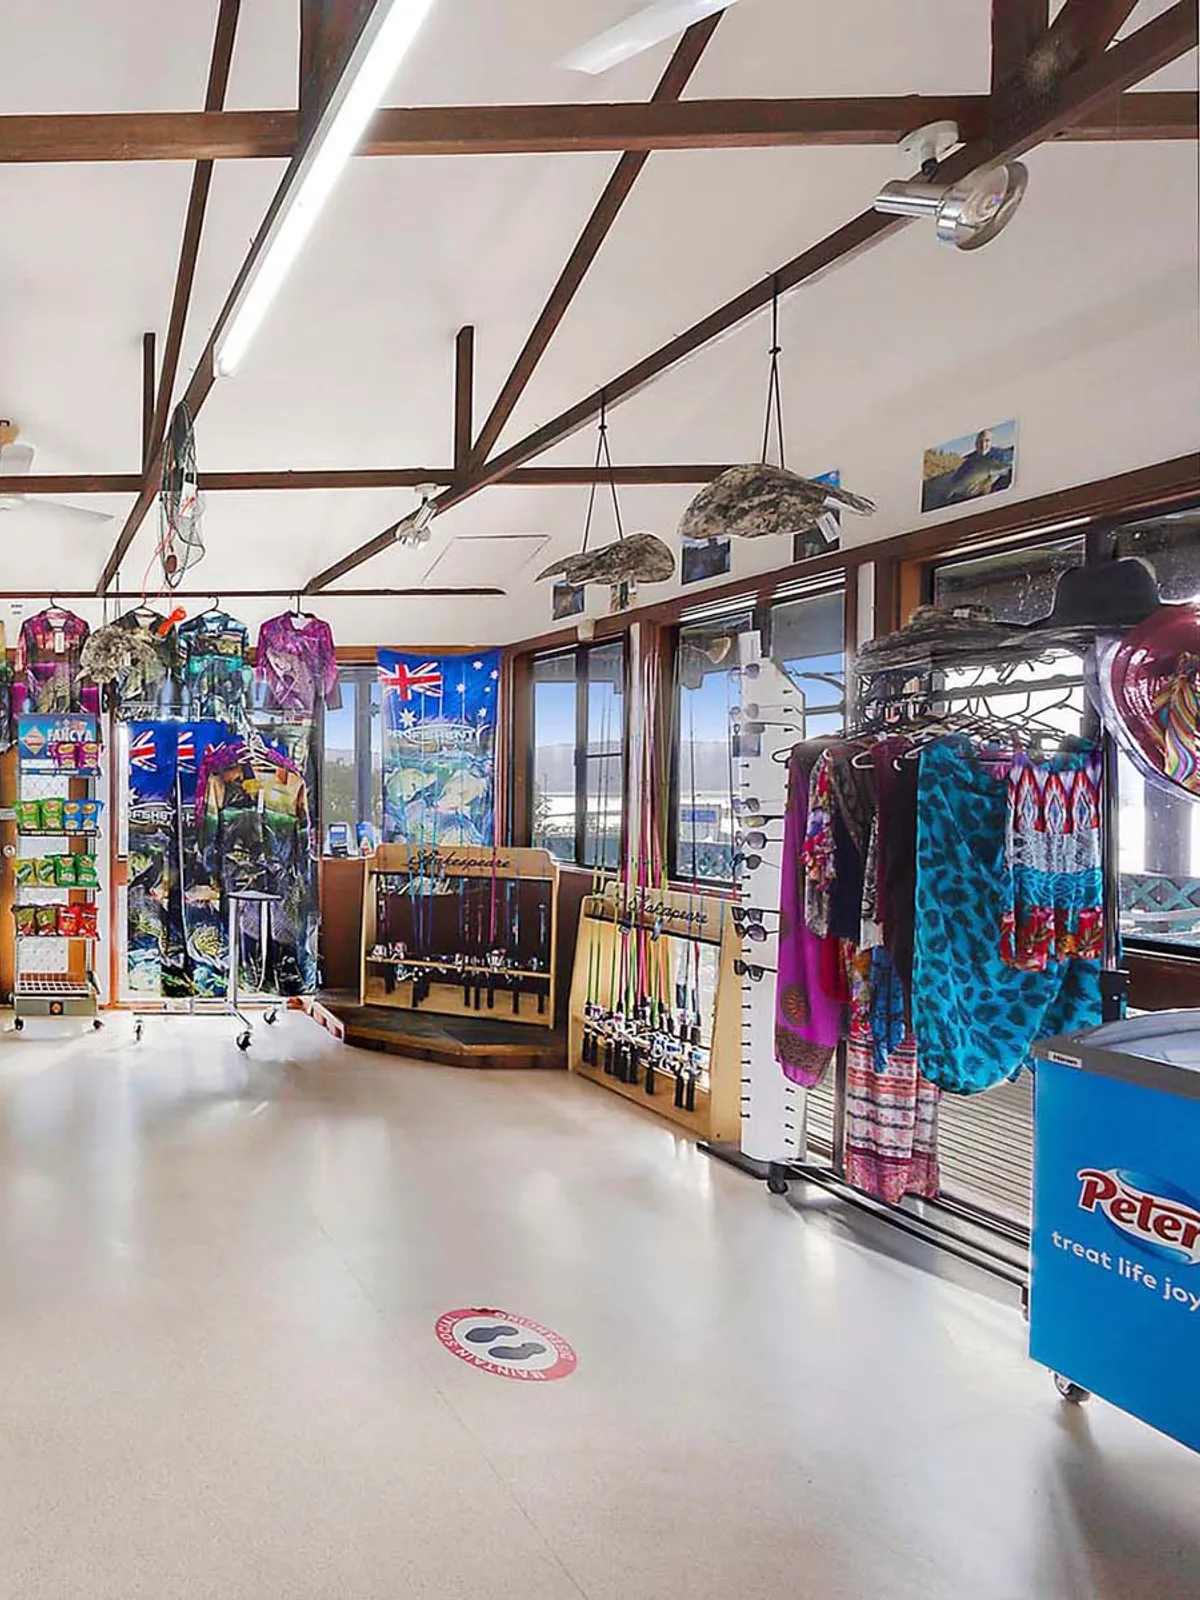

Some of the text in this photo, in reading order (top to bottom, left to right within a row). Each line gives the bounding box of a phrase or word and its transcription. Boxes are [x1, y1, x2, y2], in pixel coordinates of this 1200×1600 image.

[47, 729, 85, 742] FANCY
[1051, 1230, 1112, 1270] treat
[1118, 1257, 1156, 1290] life
[454, 1344, 548, 1380] MAINTAIN
